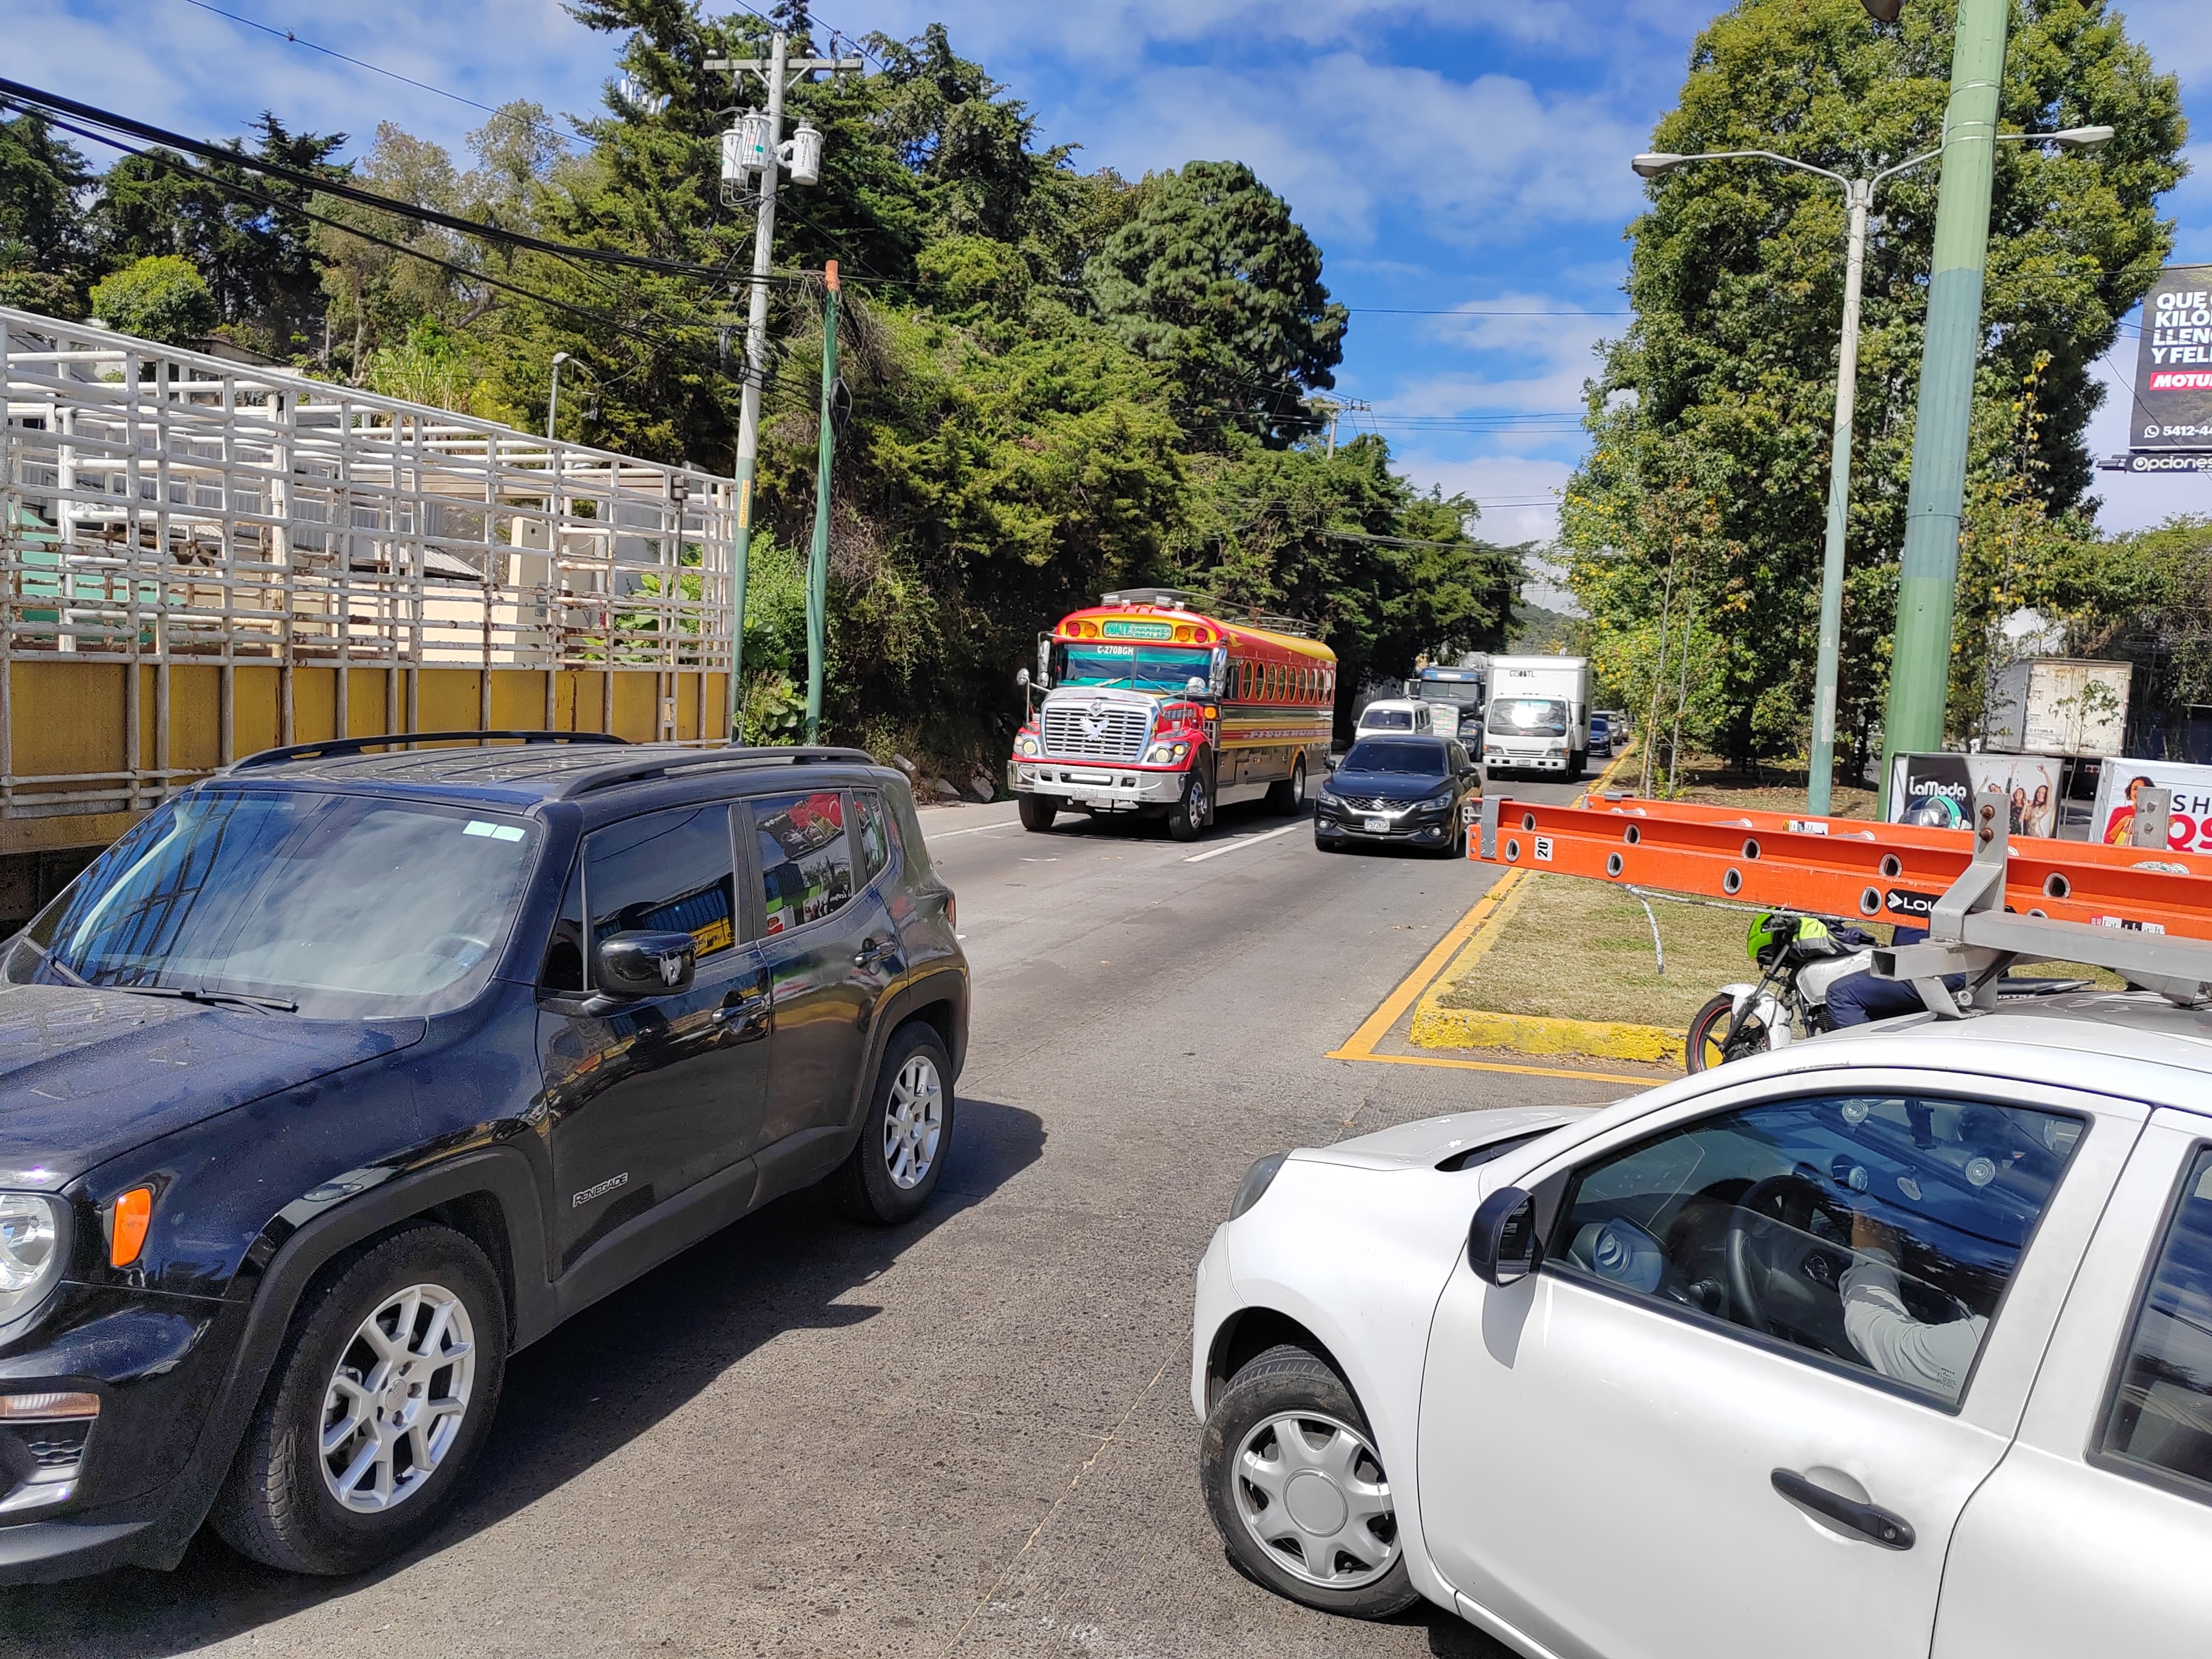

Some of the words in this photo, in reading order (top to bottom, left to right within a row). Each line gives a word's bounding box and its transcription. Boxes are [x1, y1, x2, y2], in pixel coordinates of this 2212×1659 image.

[2155, 306, 2212, 328] KILÓ
[2153, 328, 2212, 346] LLEN
[2151, 347, 2168, 365] Y
[1097, 645, 1134, 655] C-270BGH
[1910, 775, 1967, 798] LaModa
[572, 1172, 628, 1208] RENEGADE
